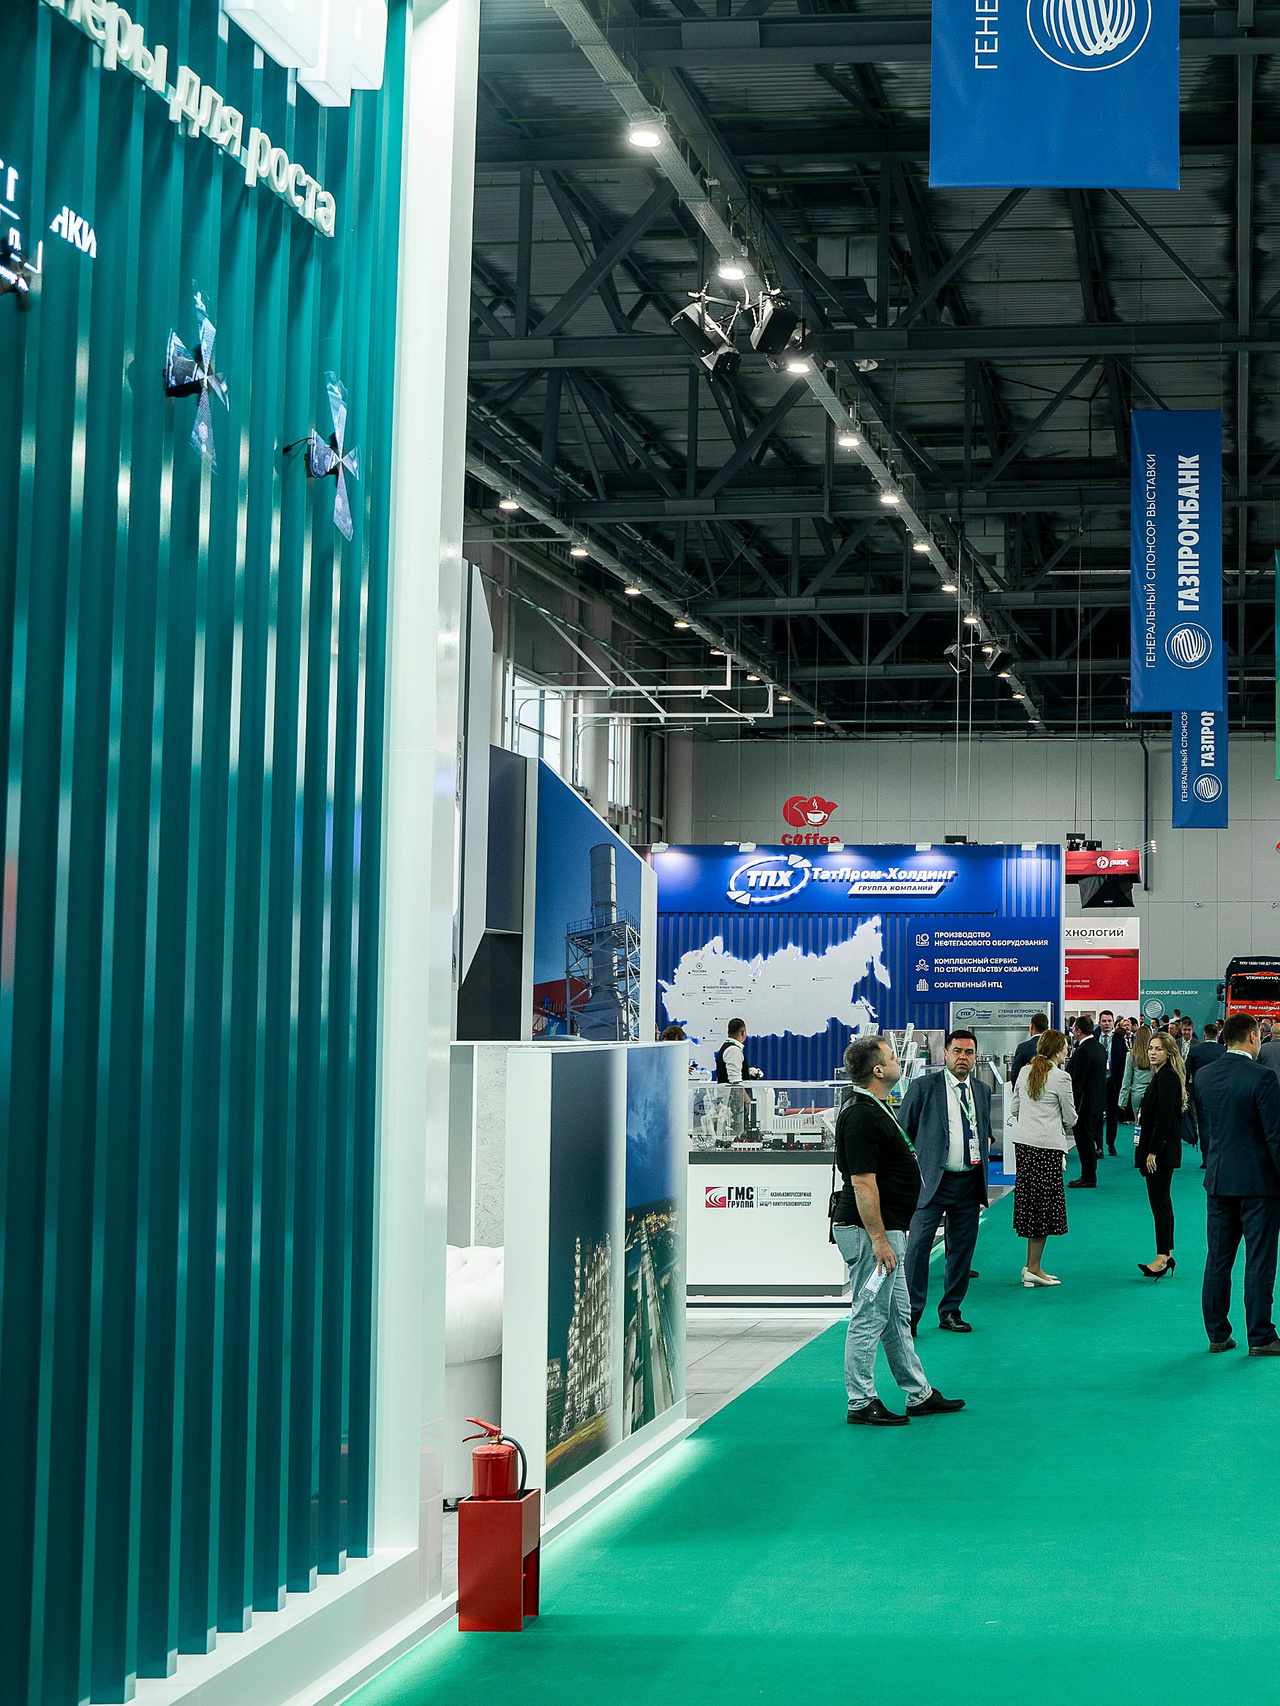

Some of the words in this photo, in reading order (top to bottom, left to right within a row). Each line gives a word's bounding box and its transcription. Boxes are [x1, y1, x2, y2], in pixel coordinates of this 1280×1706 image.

[974, 0, 999, 70] ГЕНЕ
[169, 65, 243, 158] для
[245, 127, 336, 237] роста
[1146, 454, 1156, 517] ВЫСТАВКИ
[1177, 454, 1200, 611] ГАЗПРОМБАНК
[1145, 520, 1156, 581] СПОНСОР
[1143, 585, 1156, 668] ГЕНЕРАЛЬНЫЙ
[1180, 749, 1188, 802] ГЕНЕРАЛЬНЫЙ
[747, 870, 794, 887] ТПХ
[811, 867, 957, 883] ТатПром-Холдинг
[890, 884, 933, 892] КОМПАНИЙ
[934, 931, 991, 939] ПРОИЗВОДСТВО
[1065, 927, 1124, 937] ХНОЛОГИЙ
[934, 939, 991, 947] НЕФТЕГАЗОВОГО
[992, 939, 1049, 947] ОБОРУДОВАНИЯ
[934, 957, 989, 965] КОМПЛЕКСНЫЙ
[934, 980, 987, 988] СОБСТВЕННЫЙ
[988, 981, 1003, 989] НТЦ
[728, 1187, 754, 1200] ГМС
